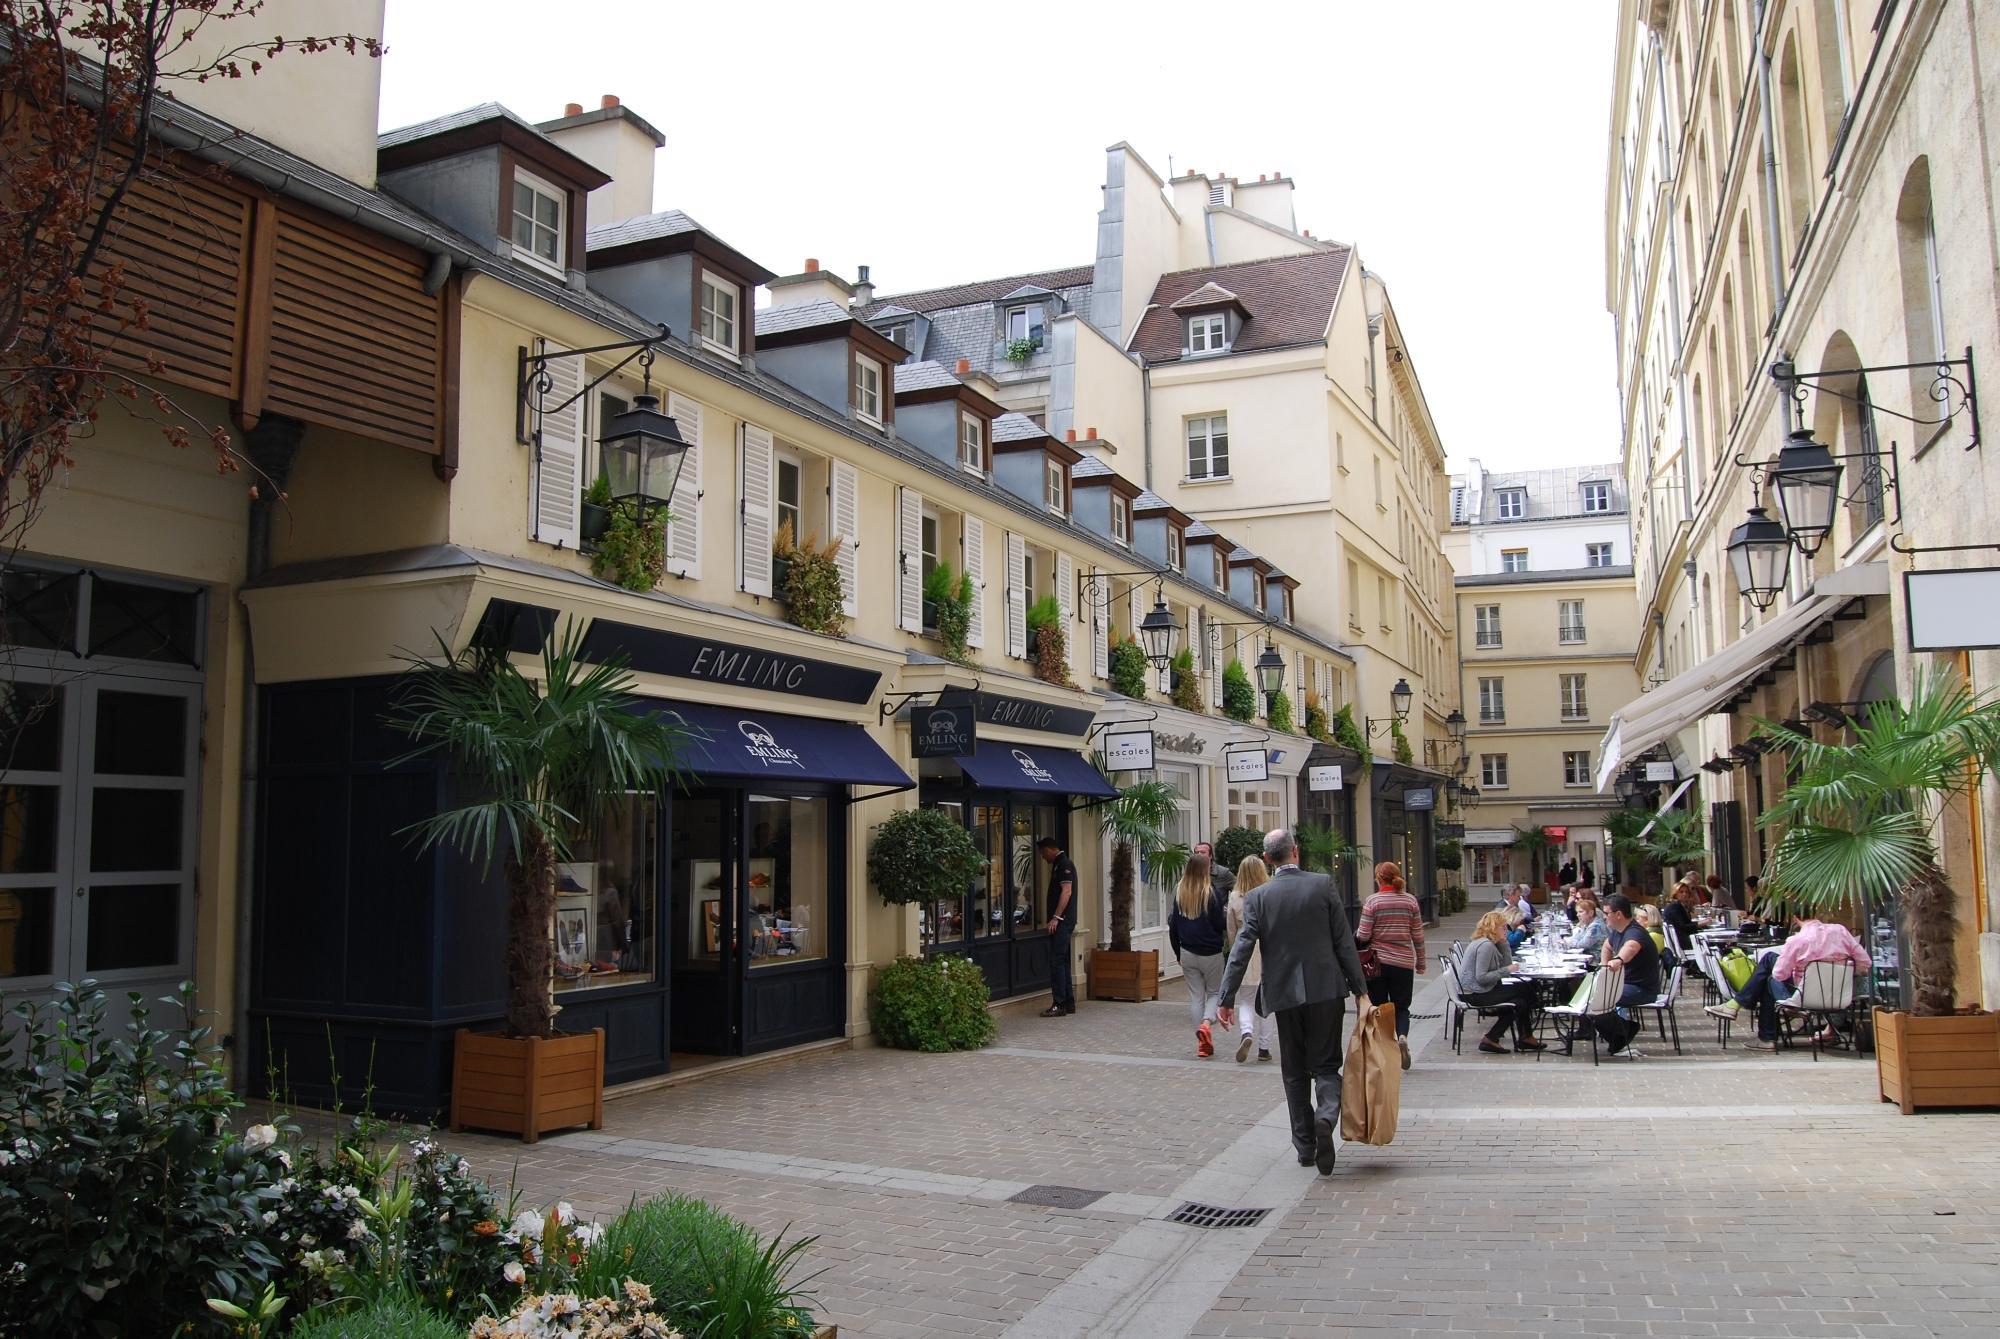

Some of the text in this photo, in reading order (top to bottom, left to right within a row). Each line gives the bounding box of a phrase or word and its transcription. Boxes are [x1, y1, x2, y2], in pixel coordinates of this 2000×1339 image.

[690, 647, 806, 689] EMLING
[991, 701, 1054, 728] EMLING
[919, 733, 968, 745] EMLING
[745, 745, 799, 760] EMLING
[1109, 747, 1150, 757] escales
[1230, 763, 1264, 771] escales
